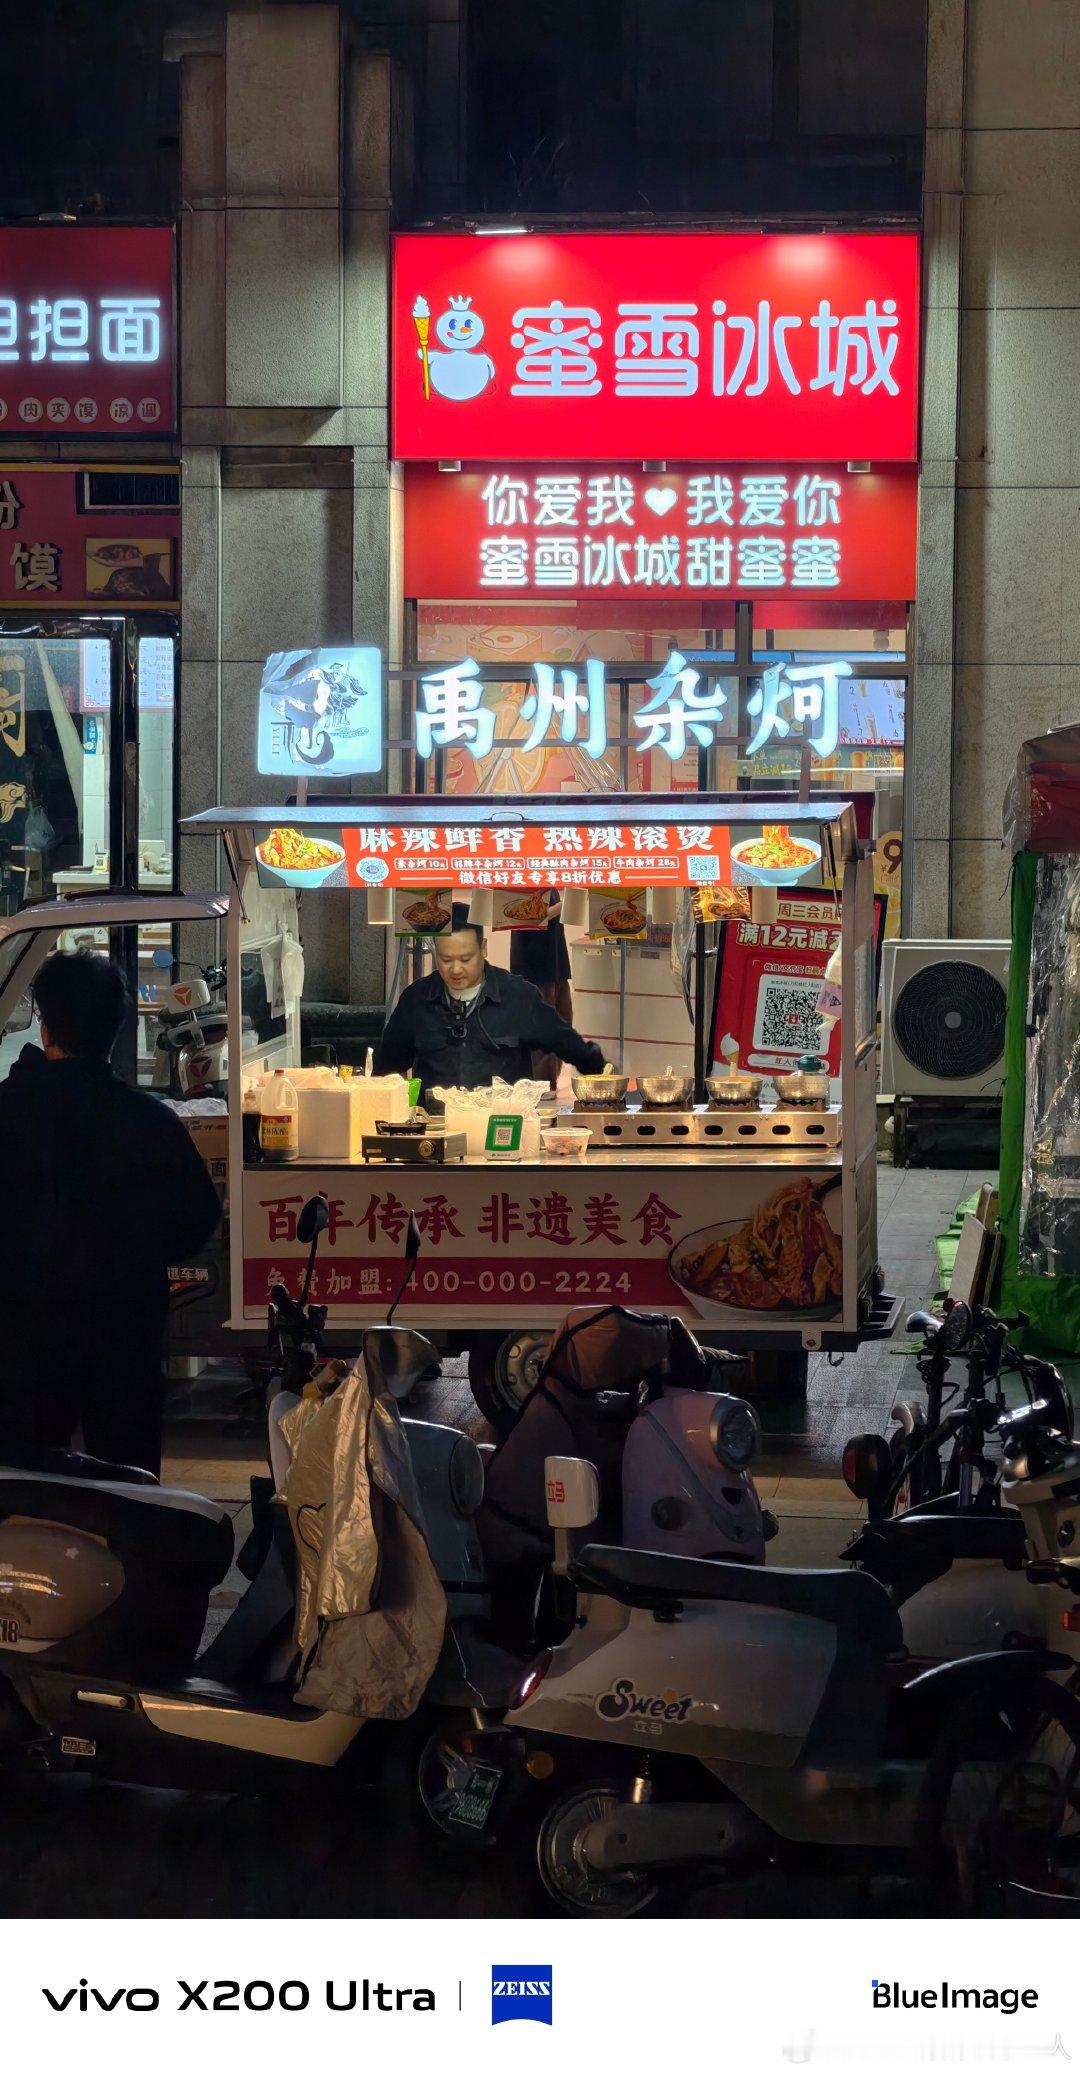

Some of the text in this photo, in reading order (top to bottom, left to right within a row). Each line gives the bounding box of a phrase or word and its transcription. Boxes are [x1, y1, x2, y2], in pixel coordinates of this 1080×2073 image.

[510, 299, 900, 397] 蜜雪冰城
[22, 400, 96, 420] 肉夹馍
[481, 475, 841, 527] 你爱我 我爱你
[479, 535, 841, 587] 蜜雪冰城甜蜜蜜
[414, 650, 853, 760] 禹州杂炣
[359, 826, 715, 854] 麻辣鲜香 热辣滚烫
[458, 870, 622, 885] 微信好友专享8折优惠
[777, 902, 842, 921] 周三会员
[478, 1192, 682, 1246] 非遗美食
[598, 1679, 692, 1721] Sweet
